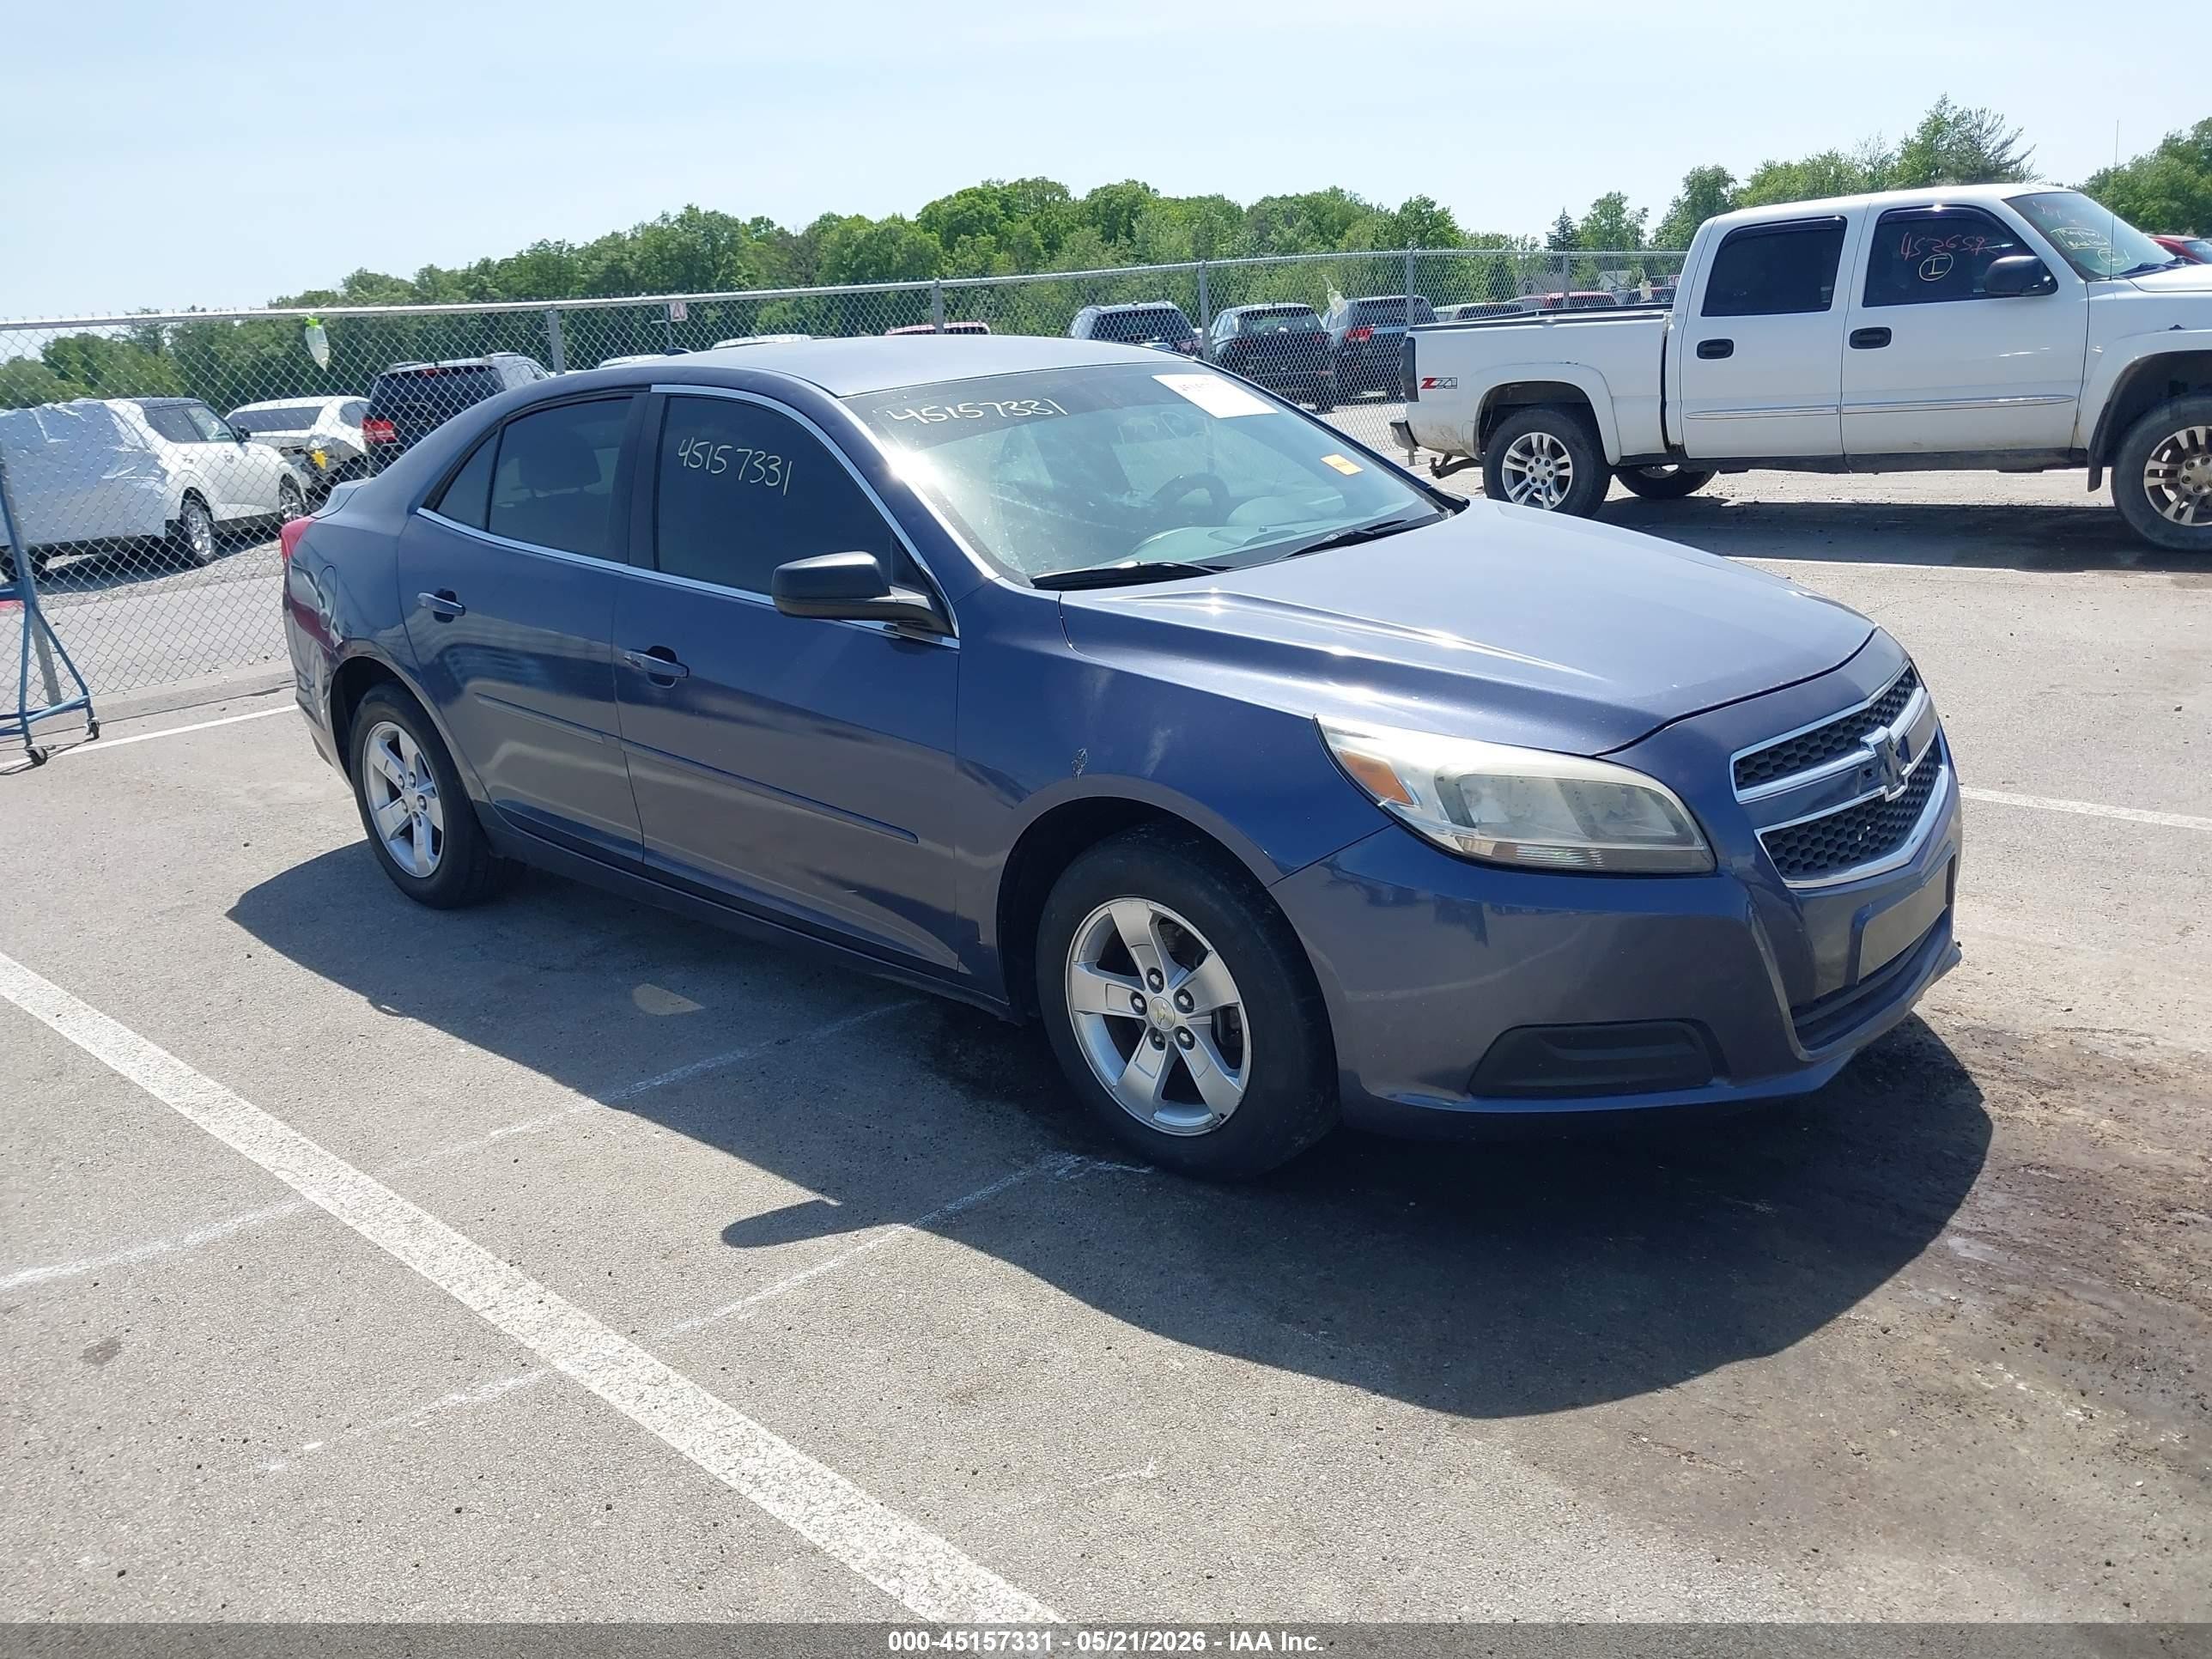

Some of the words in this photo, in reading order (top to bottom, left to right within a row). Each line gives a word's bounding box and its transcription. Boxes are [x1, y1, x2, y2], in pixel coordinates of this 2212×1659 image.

[1420, 377, 1458, 390] Z71
[885, 398, 1068, 424] 45157331
[678, 436, 793, 496] 45157331
